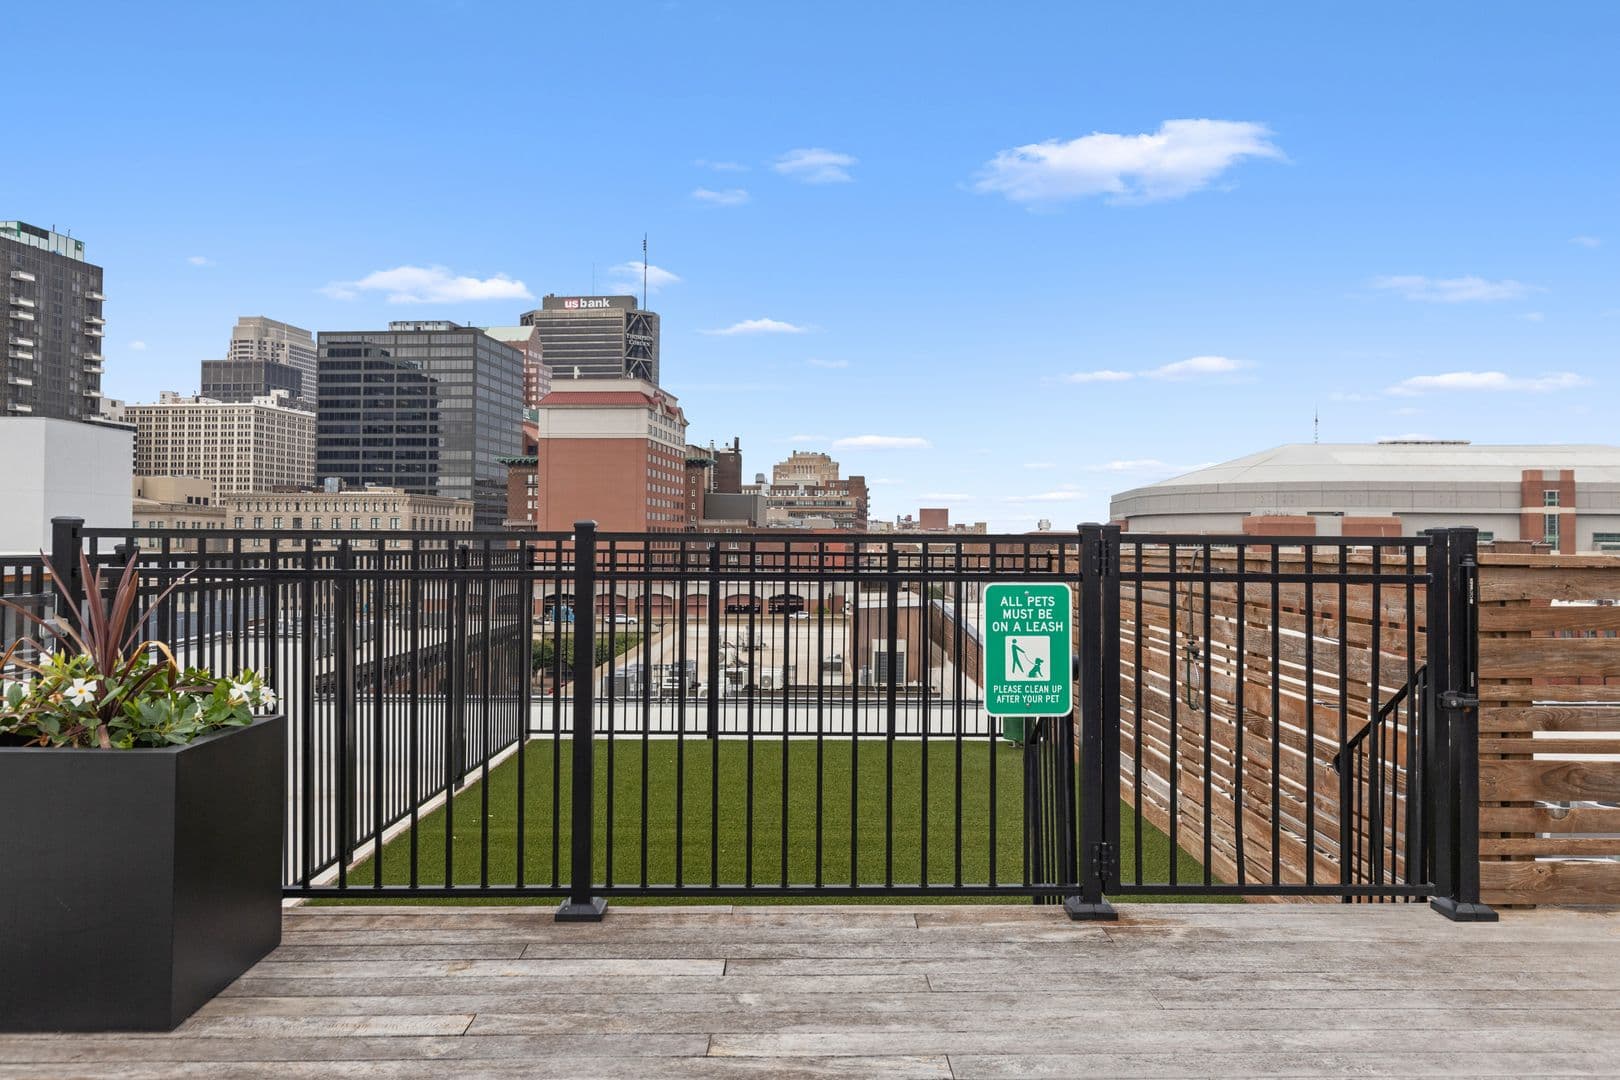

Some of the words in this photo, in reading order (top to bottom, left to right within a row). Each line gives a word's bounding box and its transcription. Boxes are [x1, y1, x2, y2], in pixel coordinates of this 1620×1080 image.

[1000, 596, 1023, 607] ALL
[1027, 596, 1056, 607] PETS
[1002, 609, 1034, 619] MUST
[1038, 609, 1053, 619] BE
[992, 622, 1009, 632] ON
[1013, 622, 1022, 632] A
[1026, 622, 1064, 632] LEASH
[993, 685, 1022, 694] PLEASE
[1024, 685, 1049, 694] CLEAN
[1052, 685, 1063, 694] UP
[996, 695, 1020, 704] AFTER
[1022, 695, 1043, 704] YOUR
[1045, 695, 1060, 704] PET
